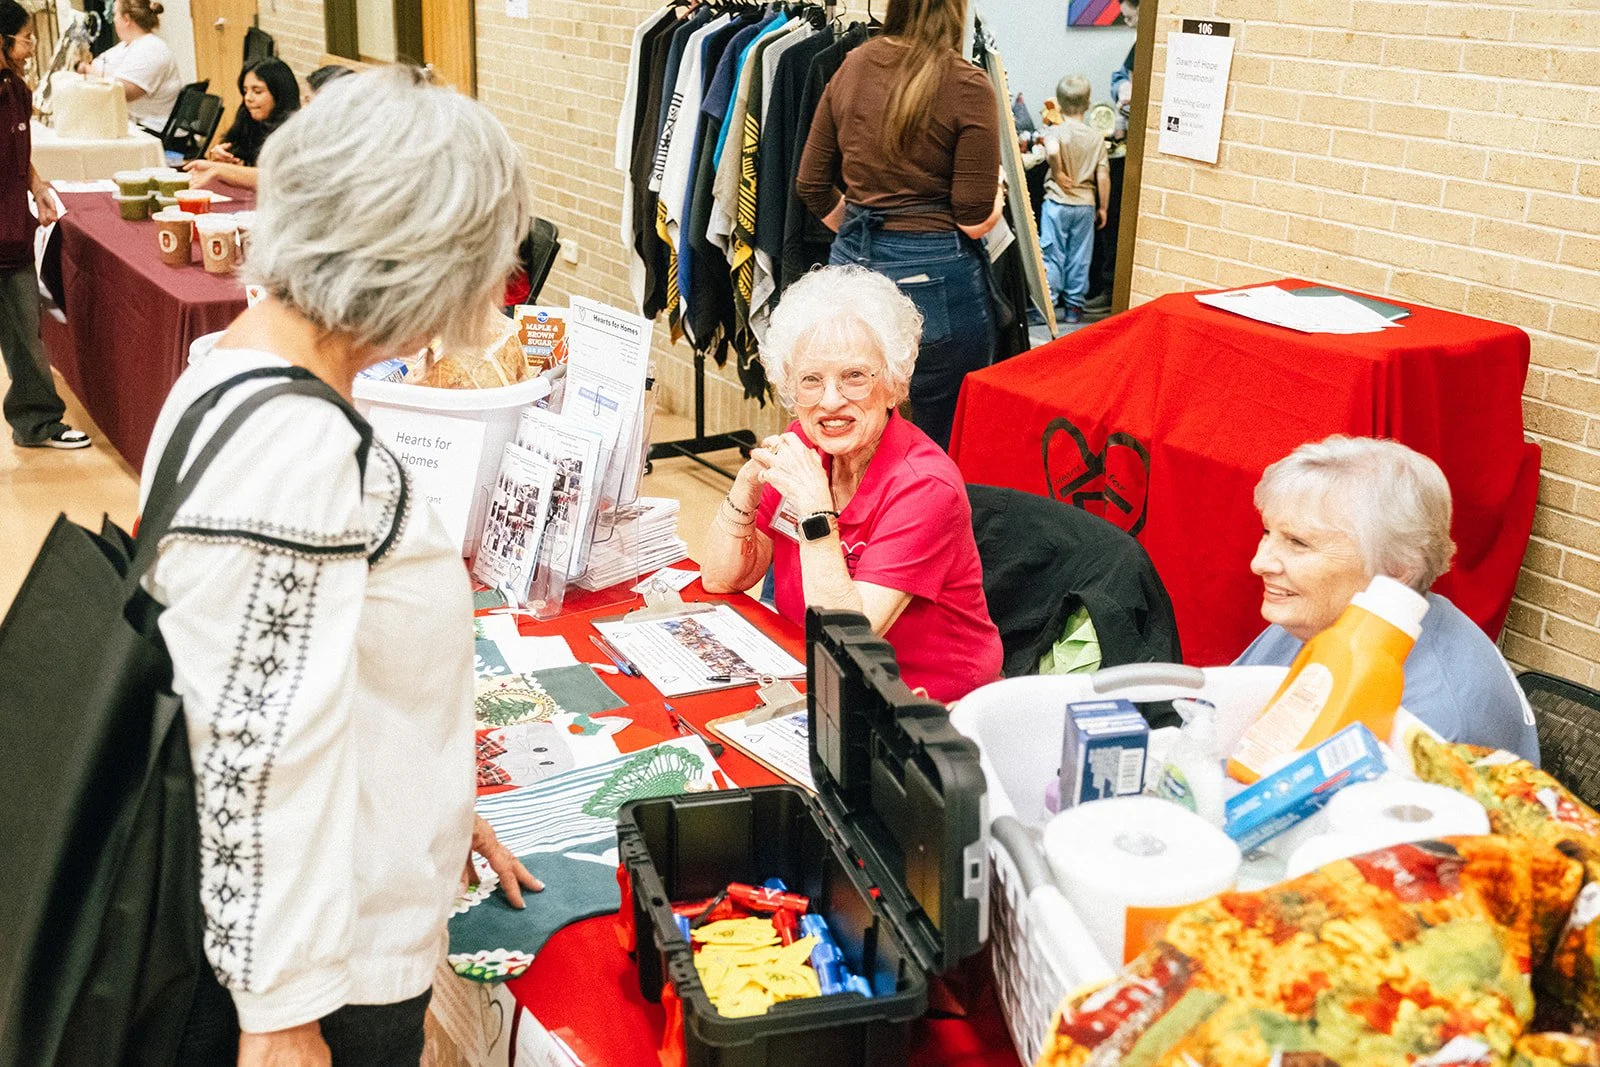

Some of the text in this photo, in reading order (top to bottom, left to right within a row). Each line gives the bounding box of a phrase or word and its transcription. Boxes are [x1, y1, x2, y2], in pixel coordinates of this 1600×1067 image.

[1198, 22, 1213, 35] 106
[1175, 57, 1218, 71] Dawn of Hope
[1175, 71, 1216, 83] International
[1196, 100, 1211, 109] Grant
[526, 323, 552, 331] MAPLE
[593, 314, 639, 336] Hearts for Homes
[527, 331, 555, 339] BROWN
[527, 338, 552, 346] SUGAR
[395, 432, 452, 450] Hearts for
[400, 452, 439, 469] Homes
[425, 496, 442, 504] rant
